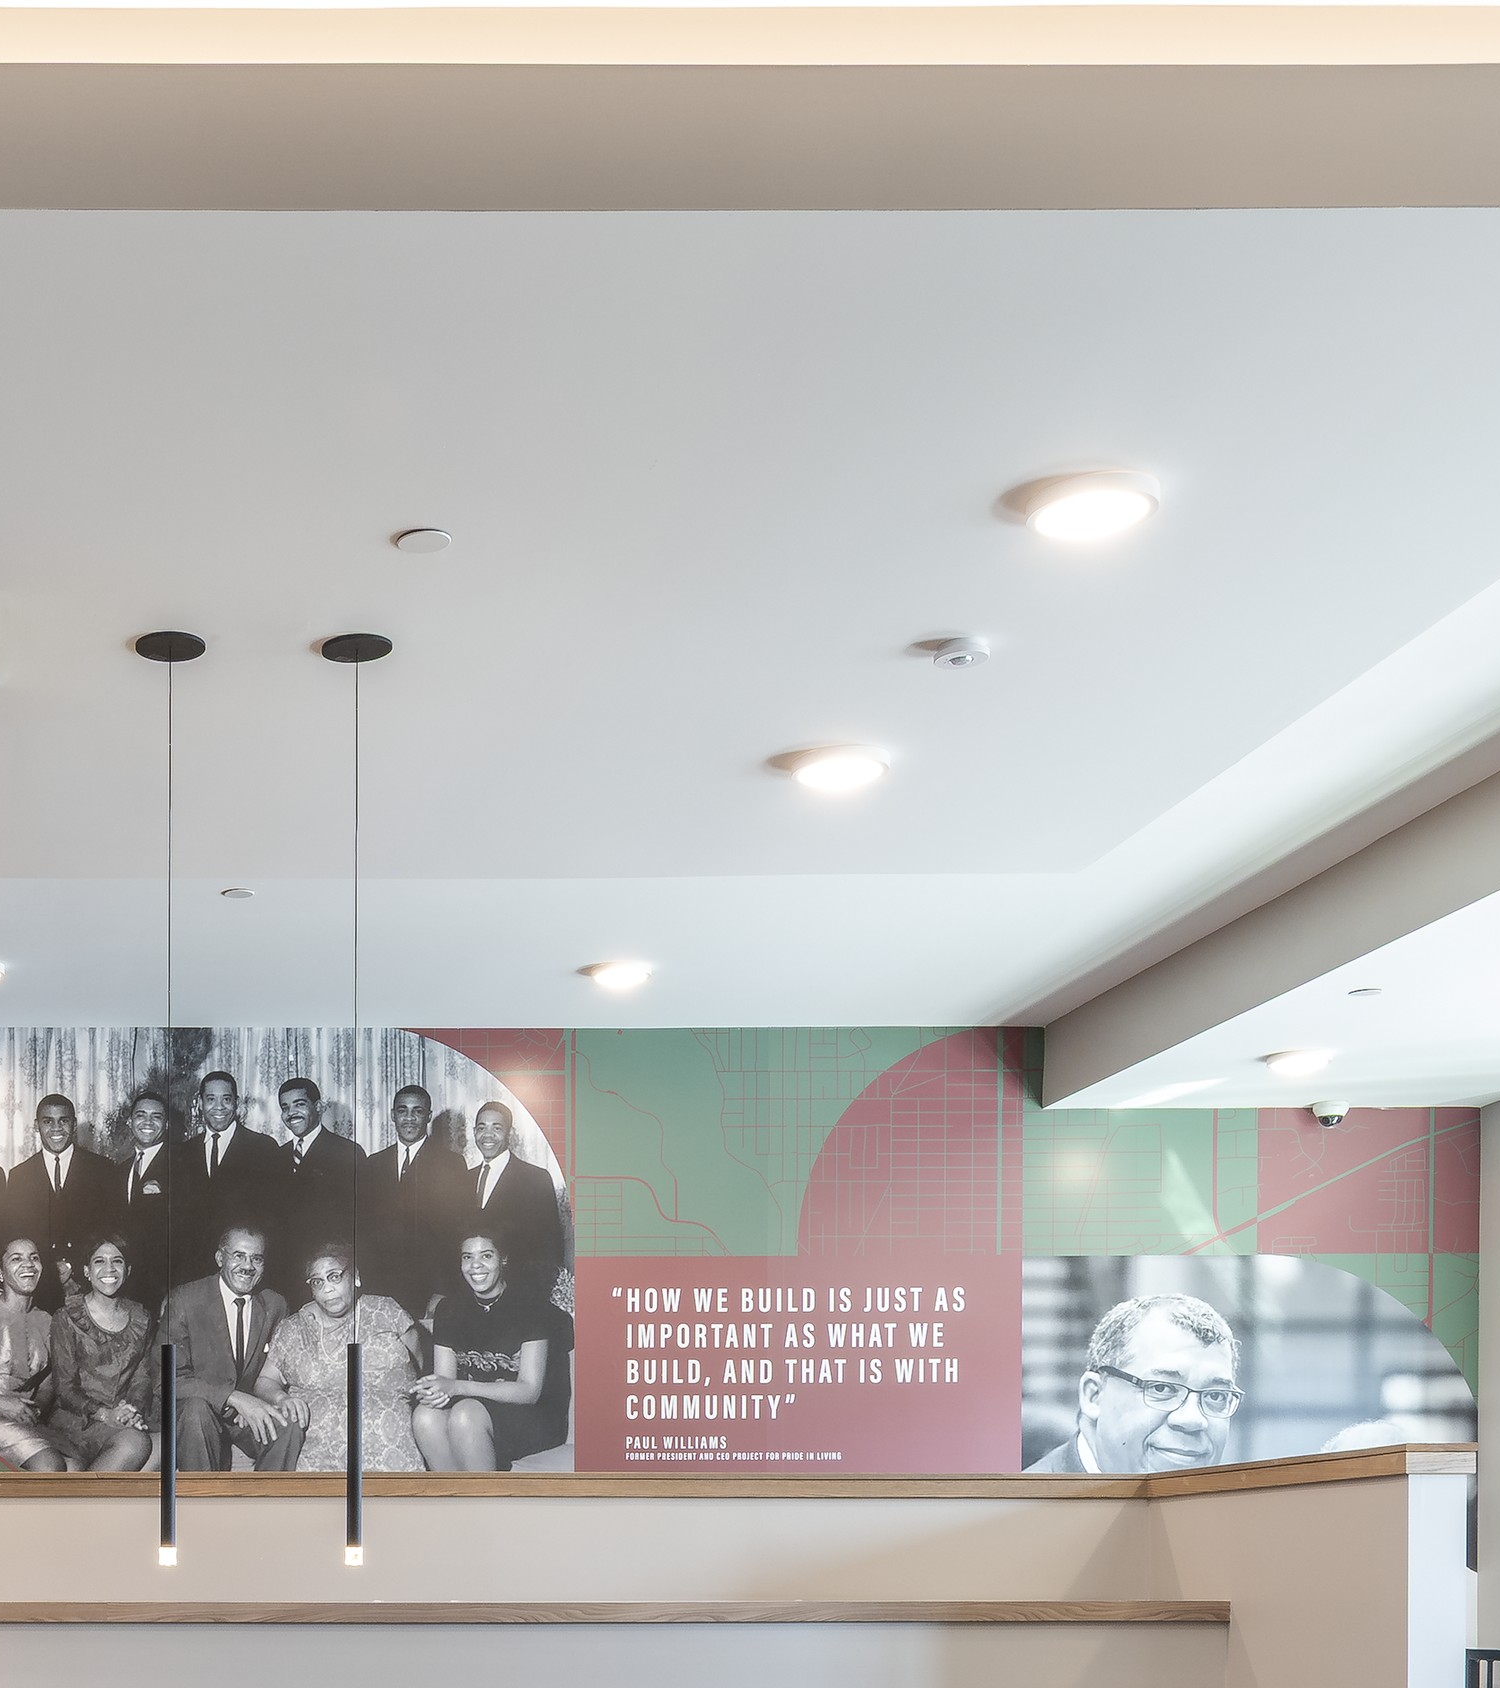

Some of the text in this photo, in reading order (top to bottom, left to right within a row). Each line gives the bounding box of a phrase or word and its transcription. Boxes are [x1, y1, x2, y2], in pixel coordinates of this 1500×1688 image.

[693, 1287, 728, 1313] WE
[741, 1287, 815, 1313] BUILD
[829, 1287, 852, 1313] IS
[863, 1286, 922, 1313] JUST
[934, 1286, 966, 1312] AS
[626, 1322, 944, 1349] IMPORTANT AS WHAT WE
[626, 1358, 959, 1387] BUILD, AND THAT IS WITH
[627, 1435, 727, 1450] PAUL WILLIAMS
[626, 1452, 842, 1461] FORMER PRESIDENT AND CEO PROJECT FOR PRIDE IN LIVING
